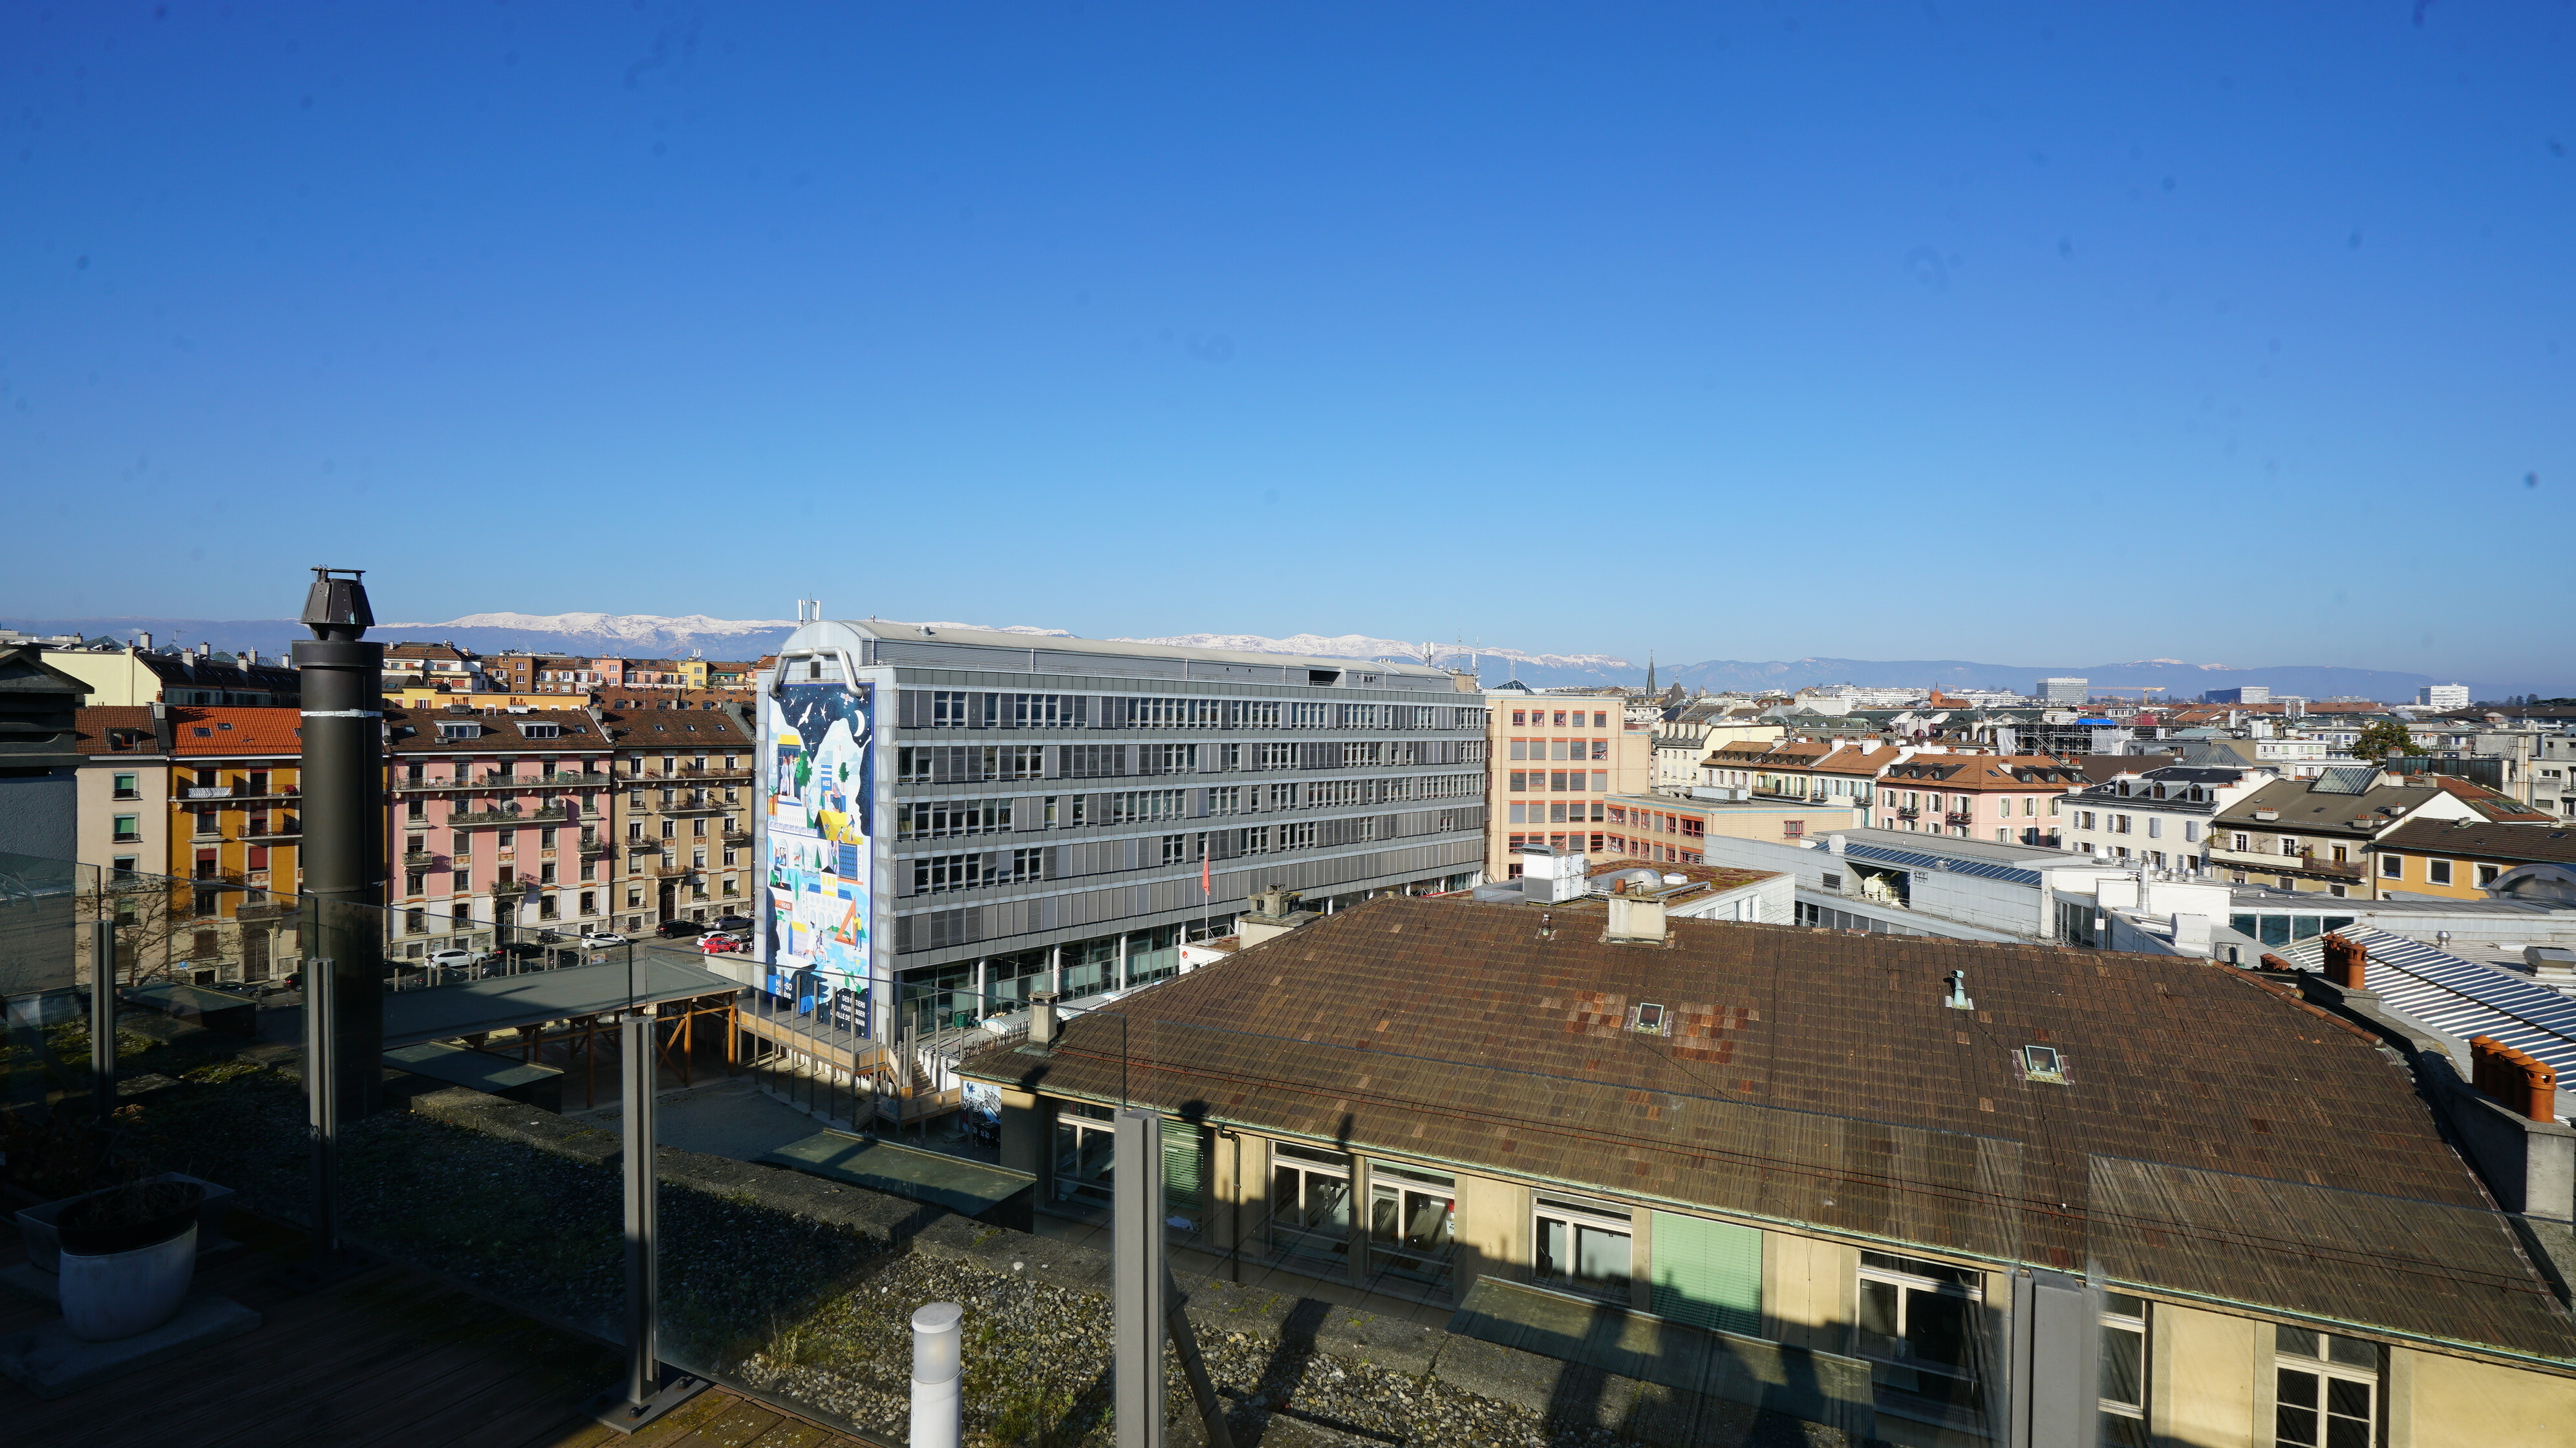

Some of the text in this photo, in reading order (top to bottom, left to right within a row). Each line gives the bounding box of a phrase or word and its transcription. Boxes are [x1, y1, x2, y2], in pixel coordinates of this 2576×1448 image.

[775, 979, 792, 991] HE-SO
[775, 987, 791, 999] Geève
[850, 997, 866, 1008] TIERS
[835, 1011, 845, 1020] VILLE
[845, 1014, 851, 1022] DE
[841, 1003, 866, 1018] POUR NSER
